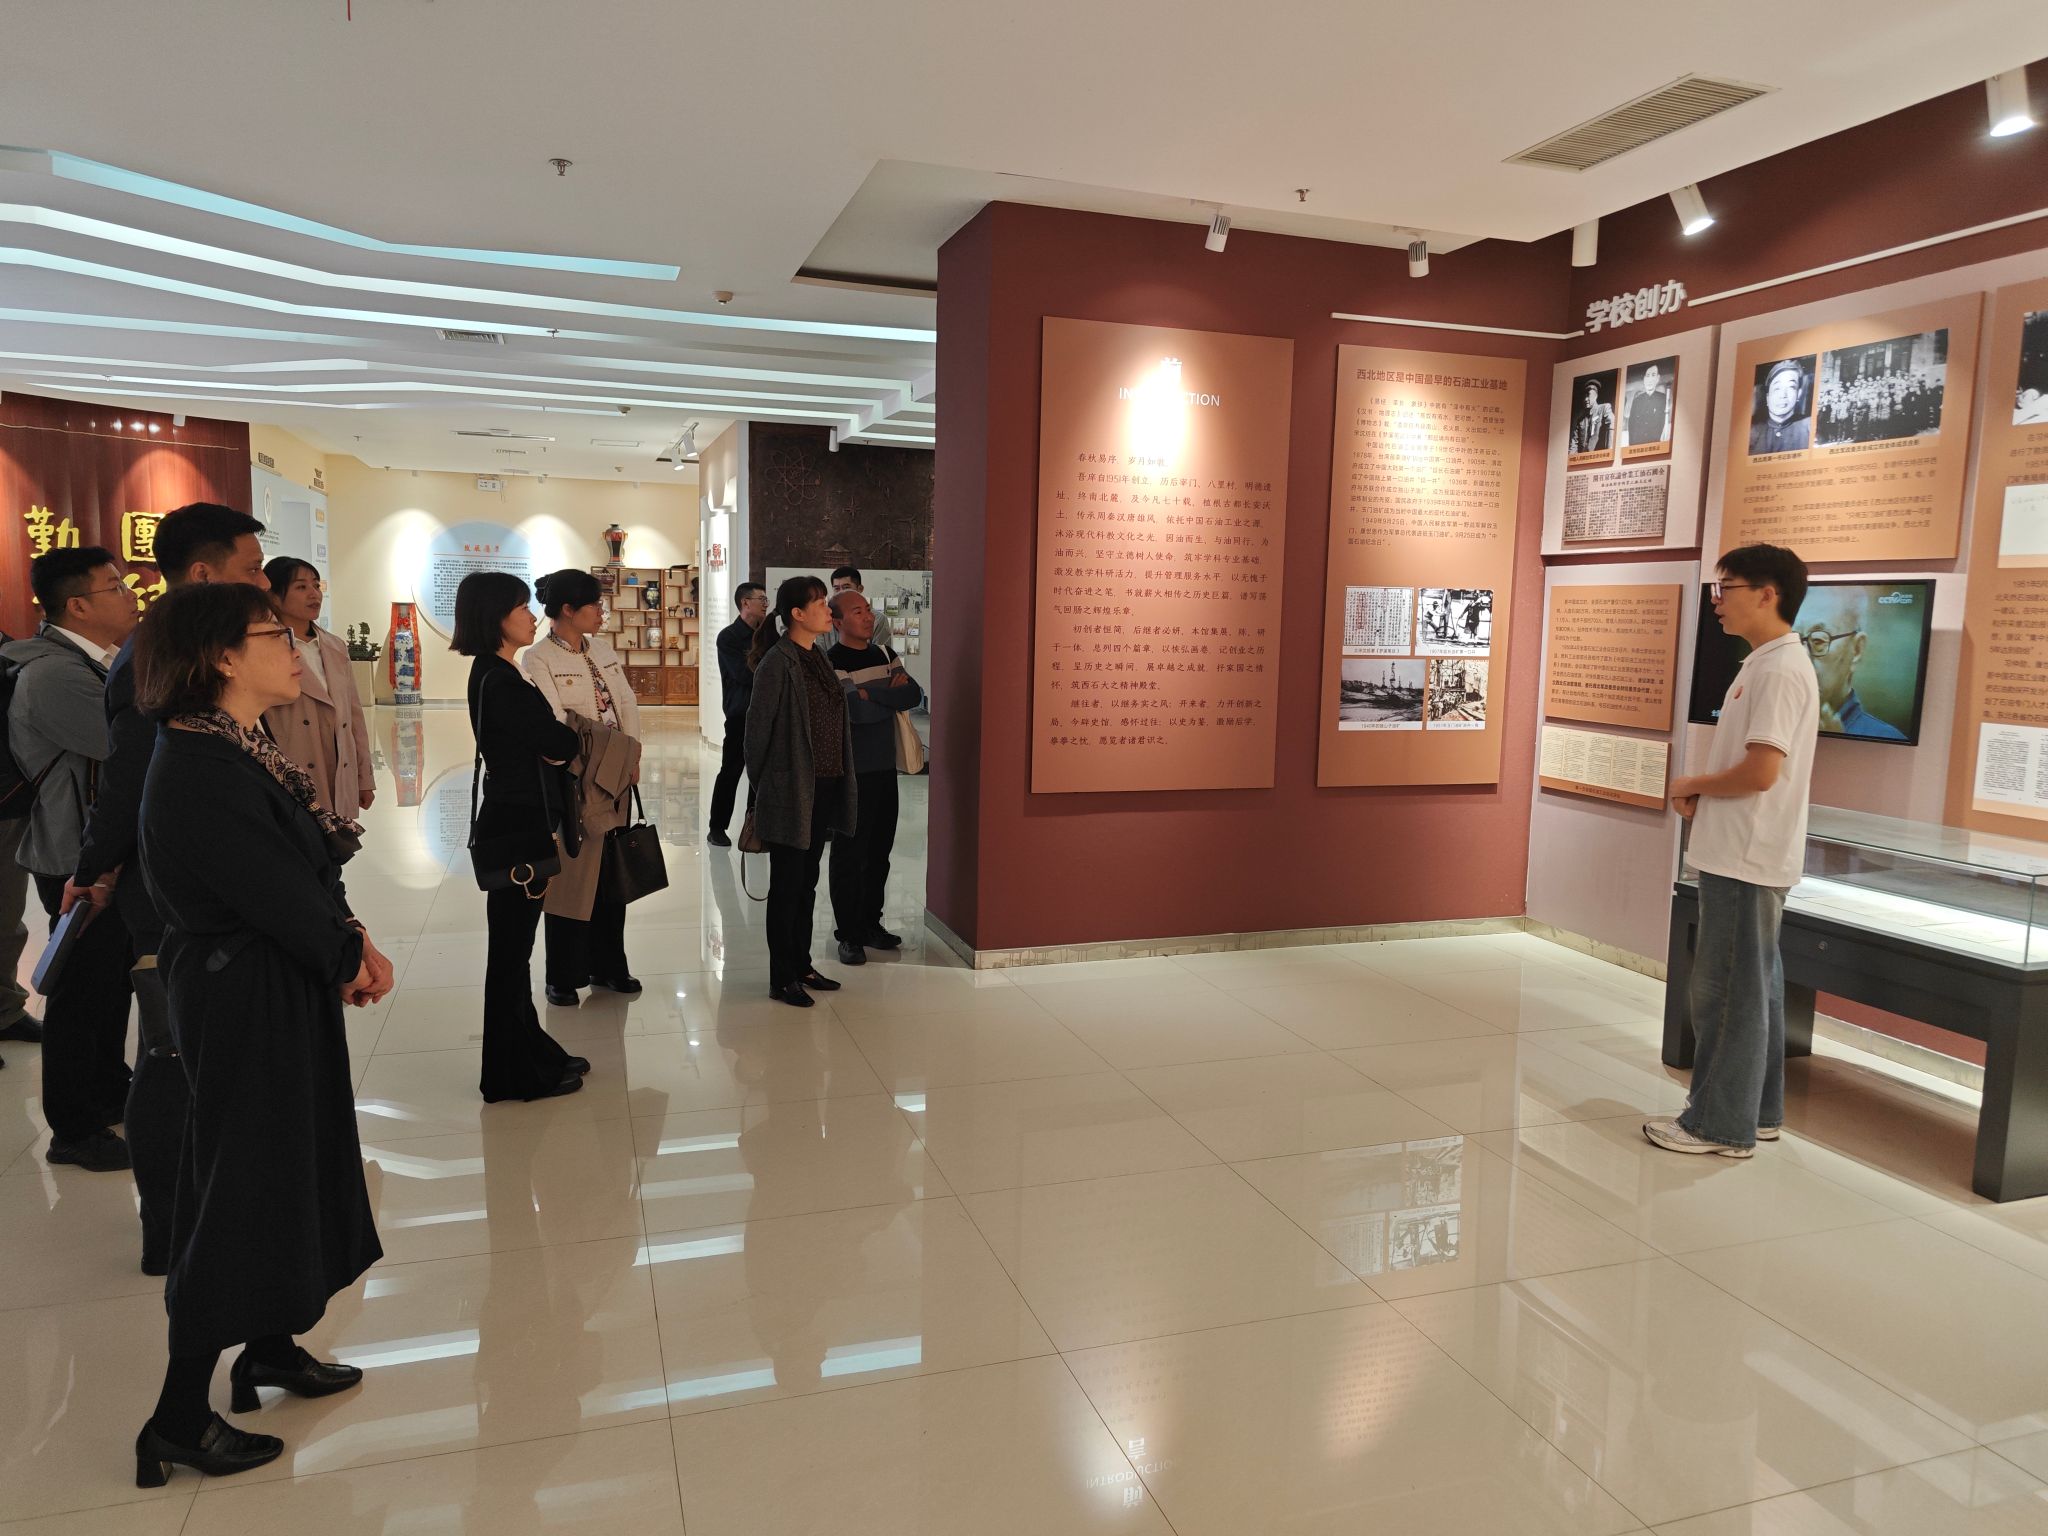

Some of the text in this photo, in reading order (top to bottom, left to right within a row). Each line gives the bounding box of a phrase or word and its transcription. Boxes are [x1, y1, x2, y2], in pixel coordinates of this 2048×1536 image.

[1585, 279, 1687, 333] 学校创办
[1356, 368, 1508, 391] 西北地区是中国最早的石油工业基地
